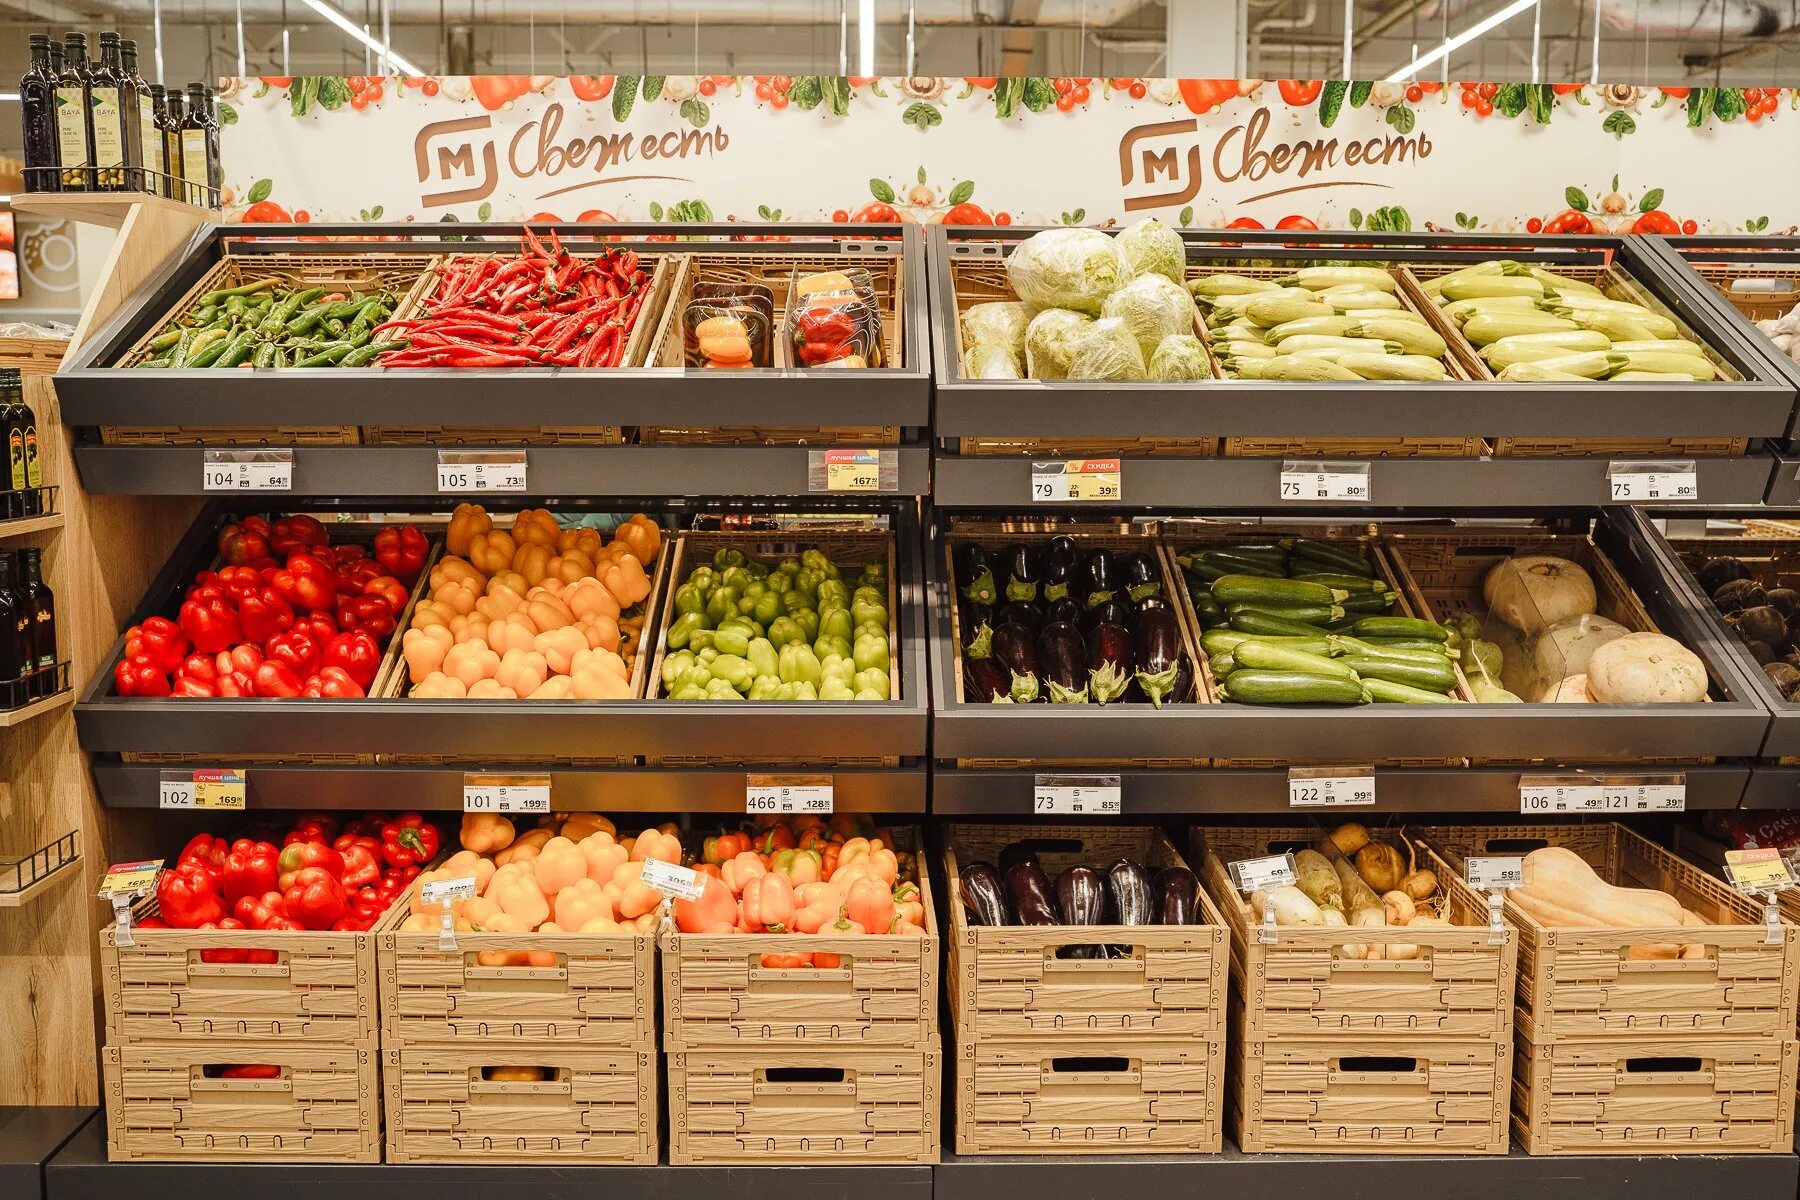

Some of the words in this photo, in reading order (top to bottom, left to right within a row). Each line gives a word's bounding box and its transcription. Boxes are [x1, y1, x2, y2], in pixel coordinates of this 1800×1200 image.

[508, 101, 729, 179] Свежесть
[1213, 106, 1433, 183] Свежесть
[206, 473, 233, 485] 104
[269, 477, 282, 485] 64
[440, 474, 467, 487] 105
[506, 477, 518, 485] 73
[853, 477, 871, 485] 167
[1035, 484, 1053, 497] 79
[1099, 487, 1111, 495] 39
[1283, 482, 1300, 495] 75
[1347, 487, 1359, 495] 80
[1613, 483, 1631, 496] 75
[162, 791, 188, 804] 102
[219, 796, 237, 804] 169
[1292, 788, 1318, 801] 122
[1354, 791, 1366, 800] 99
[466, 795, 490, 808] 101
[747, 796, 776, 809] 466
[806, 800, 824, 808] 128
[1036, 796, 1054, 809] 73
[1101, 801, 1114, 809] 85
[1523, 796, 1549, 809] 106
[1584, 799, 1597, 807] 49
[1605, 795, 1629, 808] 121
[1665, 798, 1678, 806] 39
